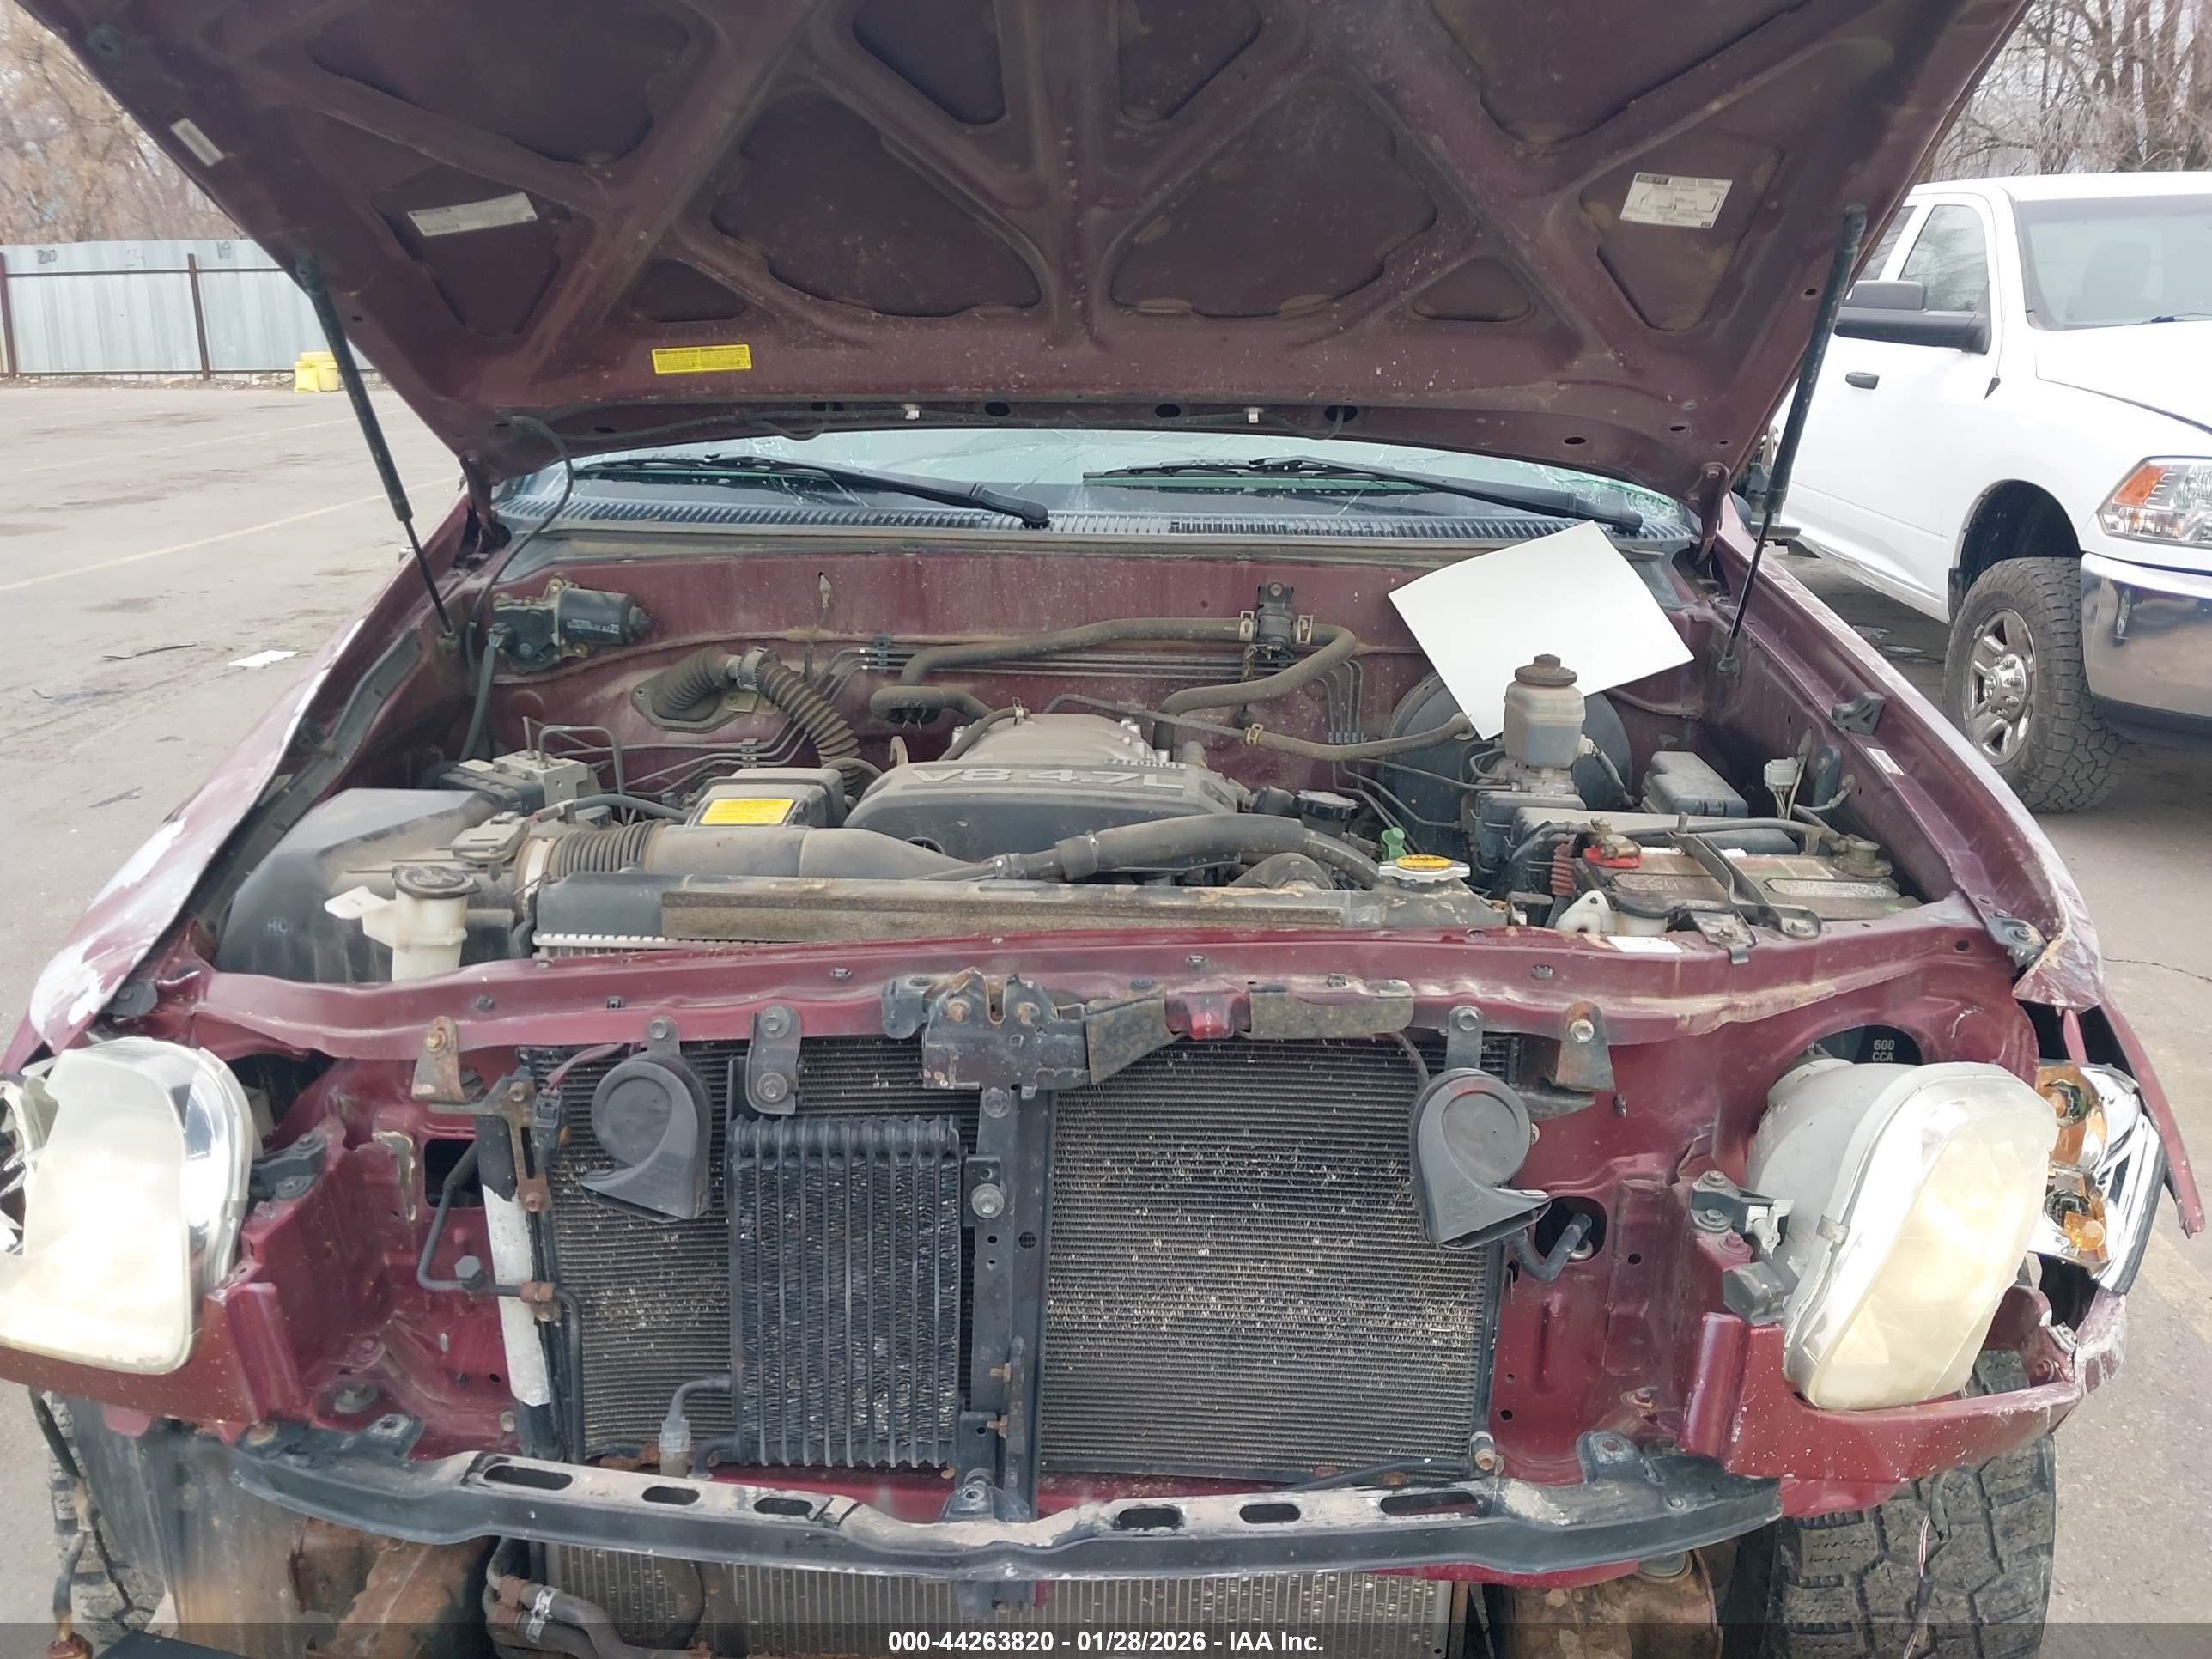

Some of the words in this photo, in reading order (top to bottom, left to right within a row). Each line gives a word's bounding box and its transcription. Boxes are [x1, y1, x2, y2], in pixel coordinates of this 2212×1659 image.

[913, 769, 1012, 782] V8
[1027, 769, 1184, 789] 4.7L
[1874, 1039, 1895, 1051] 600
[1872, 1051, 1893, 1062] CCA
